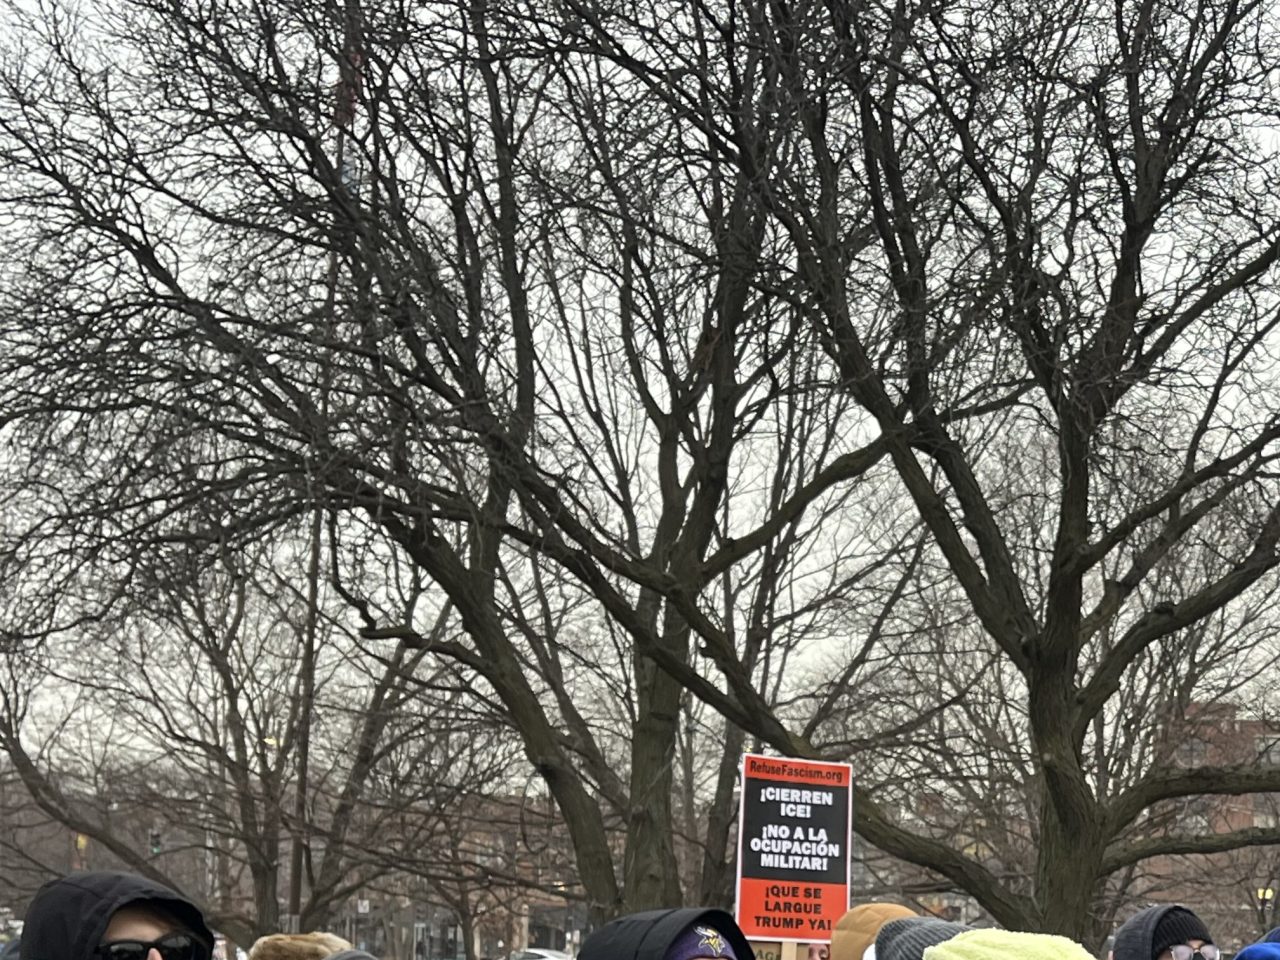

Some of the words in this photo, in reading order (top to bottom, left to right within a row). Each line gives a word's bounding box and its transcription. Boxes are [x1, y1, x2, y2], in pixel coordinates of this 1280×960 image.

[749, 760, 843, 783] RefuseFascism.org
[780, 803, 812, 818] ICE!
[793, 826, 805, 841] A
[808, 828, 829, 842] LA
[750, 837, 840, 858] OCUPACIÓN
[760, 853, 829, 871] MILITAR!
[803, 887, 822, 899] SE
[764, 901, 822, 915] LARGUE
[754, 915, 804, 929] TRUMP
[809, 919, 832, 931] YA!
